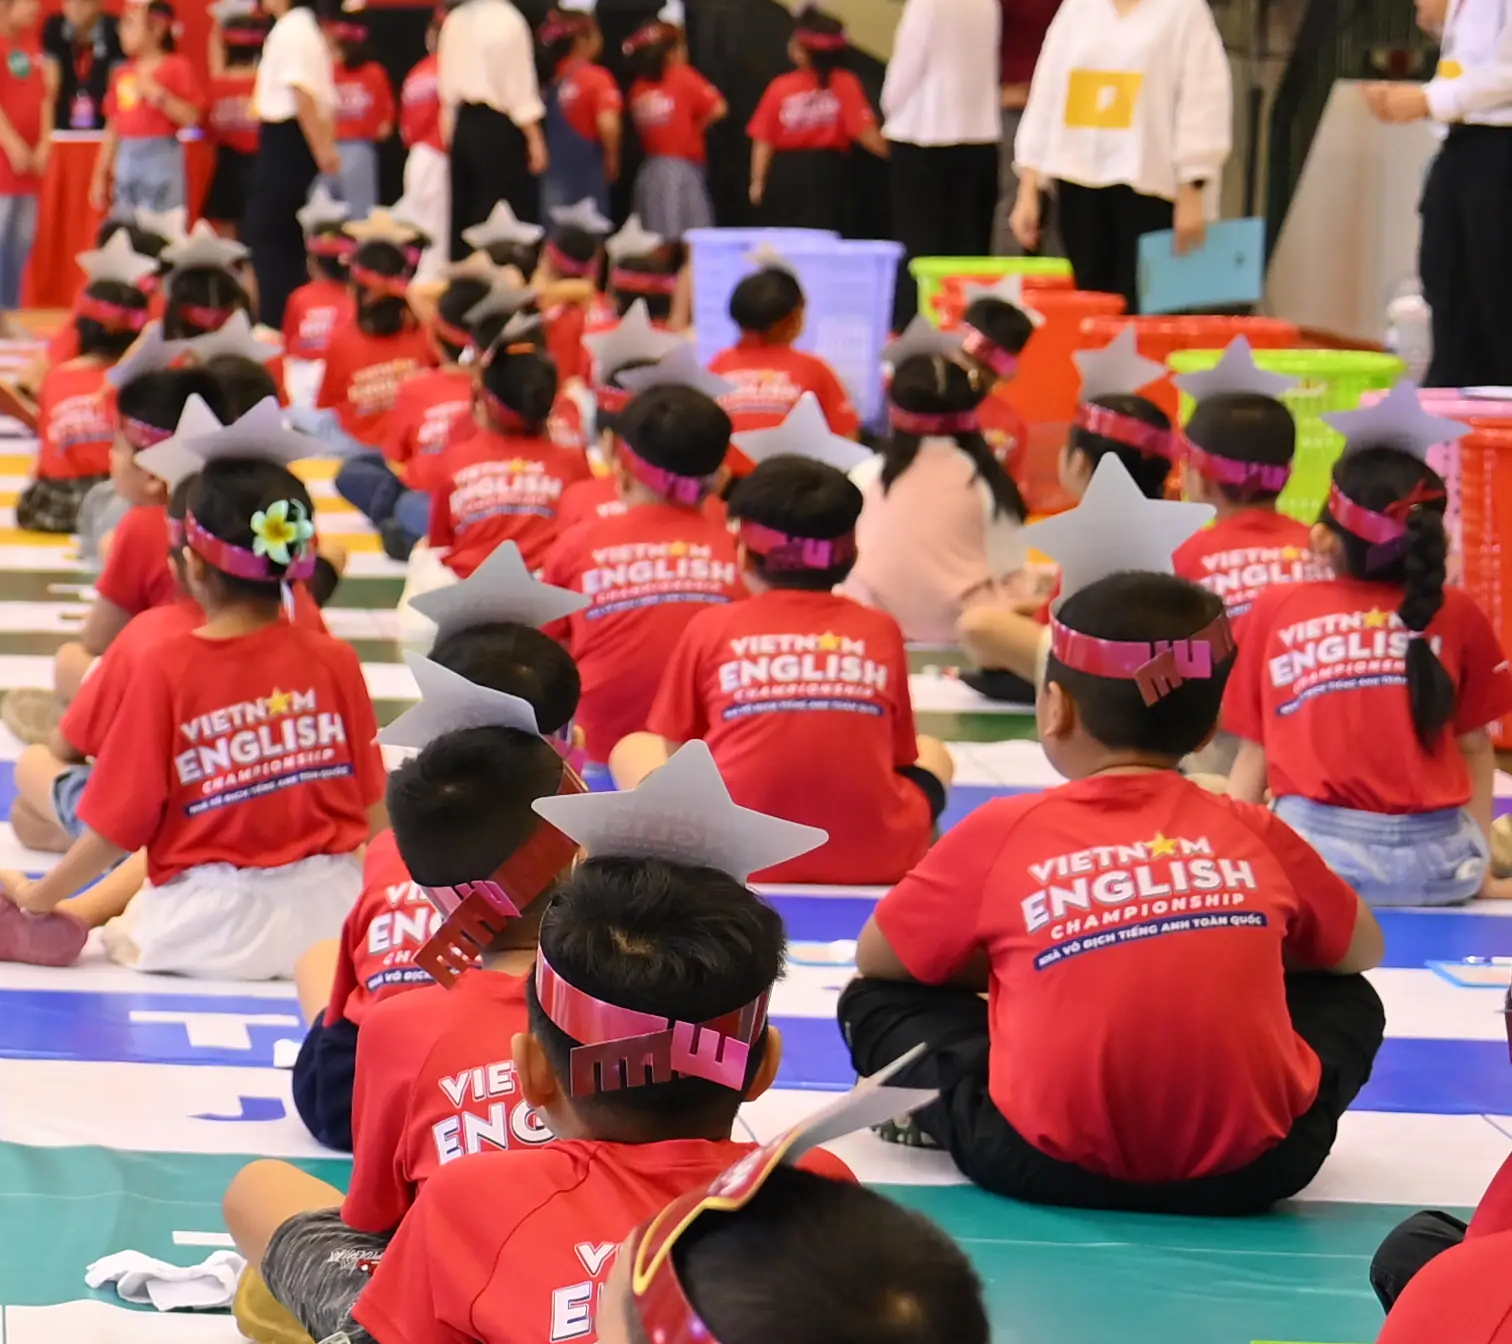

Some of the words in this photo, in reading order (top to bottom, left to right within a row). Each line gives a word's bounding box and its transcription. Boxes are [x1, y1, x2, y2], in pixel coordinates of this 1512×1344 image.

[719, 654, 888, 694] ENGLISH
[175, 712, 346, 784] ENGLISH
[201, 748, 335, 794] CHAMPIONSHIP
[1021, 858, 1256, 933] ENGLISH
[1050, 893, 1245, 940] CHAMPIONSHIP
[1117, 922, 1157, 945] TIẾNG
[1161, 921, 1189, 936] ANH
